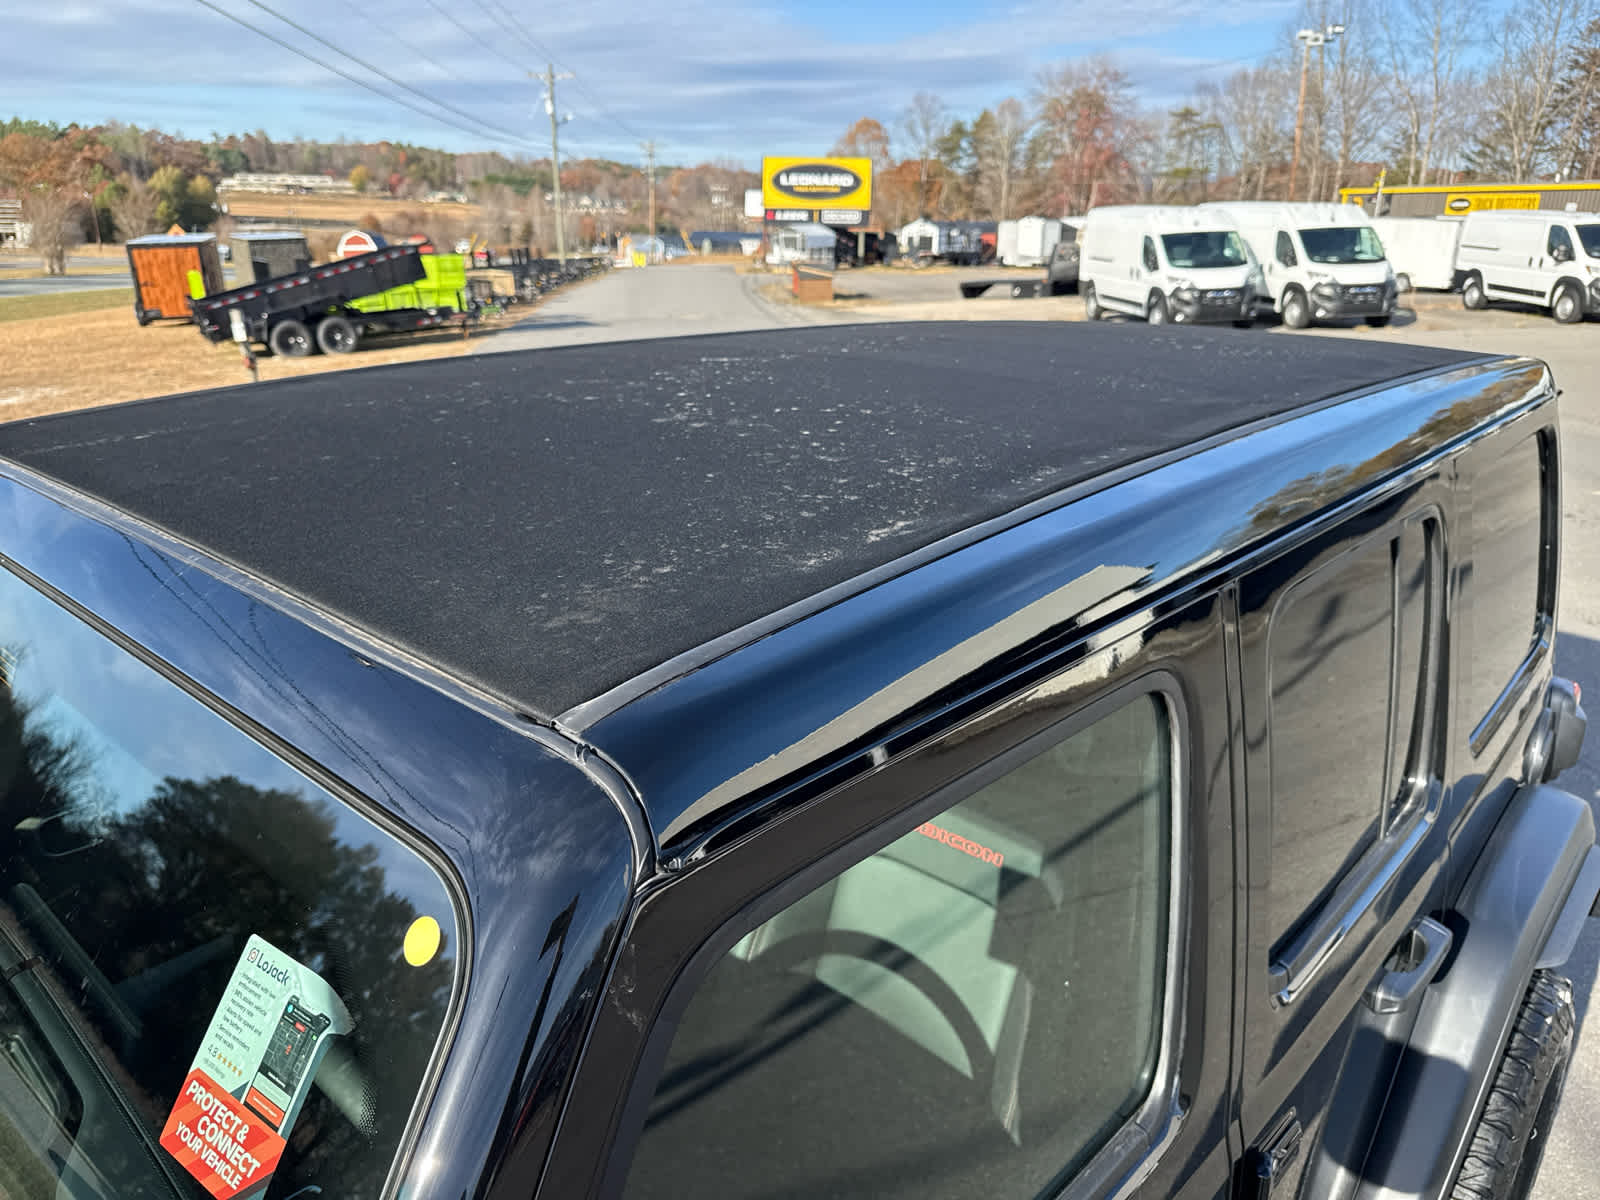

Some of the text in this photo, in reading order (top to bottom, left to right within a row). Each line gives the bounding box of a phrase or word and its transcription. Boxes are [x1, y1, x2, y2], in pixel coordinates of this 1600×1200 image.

[913, 823, 1004, 868] BICON
[187, 1080, 242, 1134] PROTECT
[237, 1124, 249, 1144] &
[176, 1121, 243, 1190] YOUR VEHICLE
[197, 1115, 261, 1178] CONNECT
